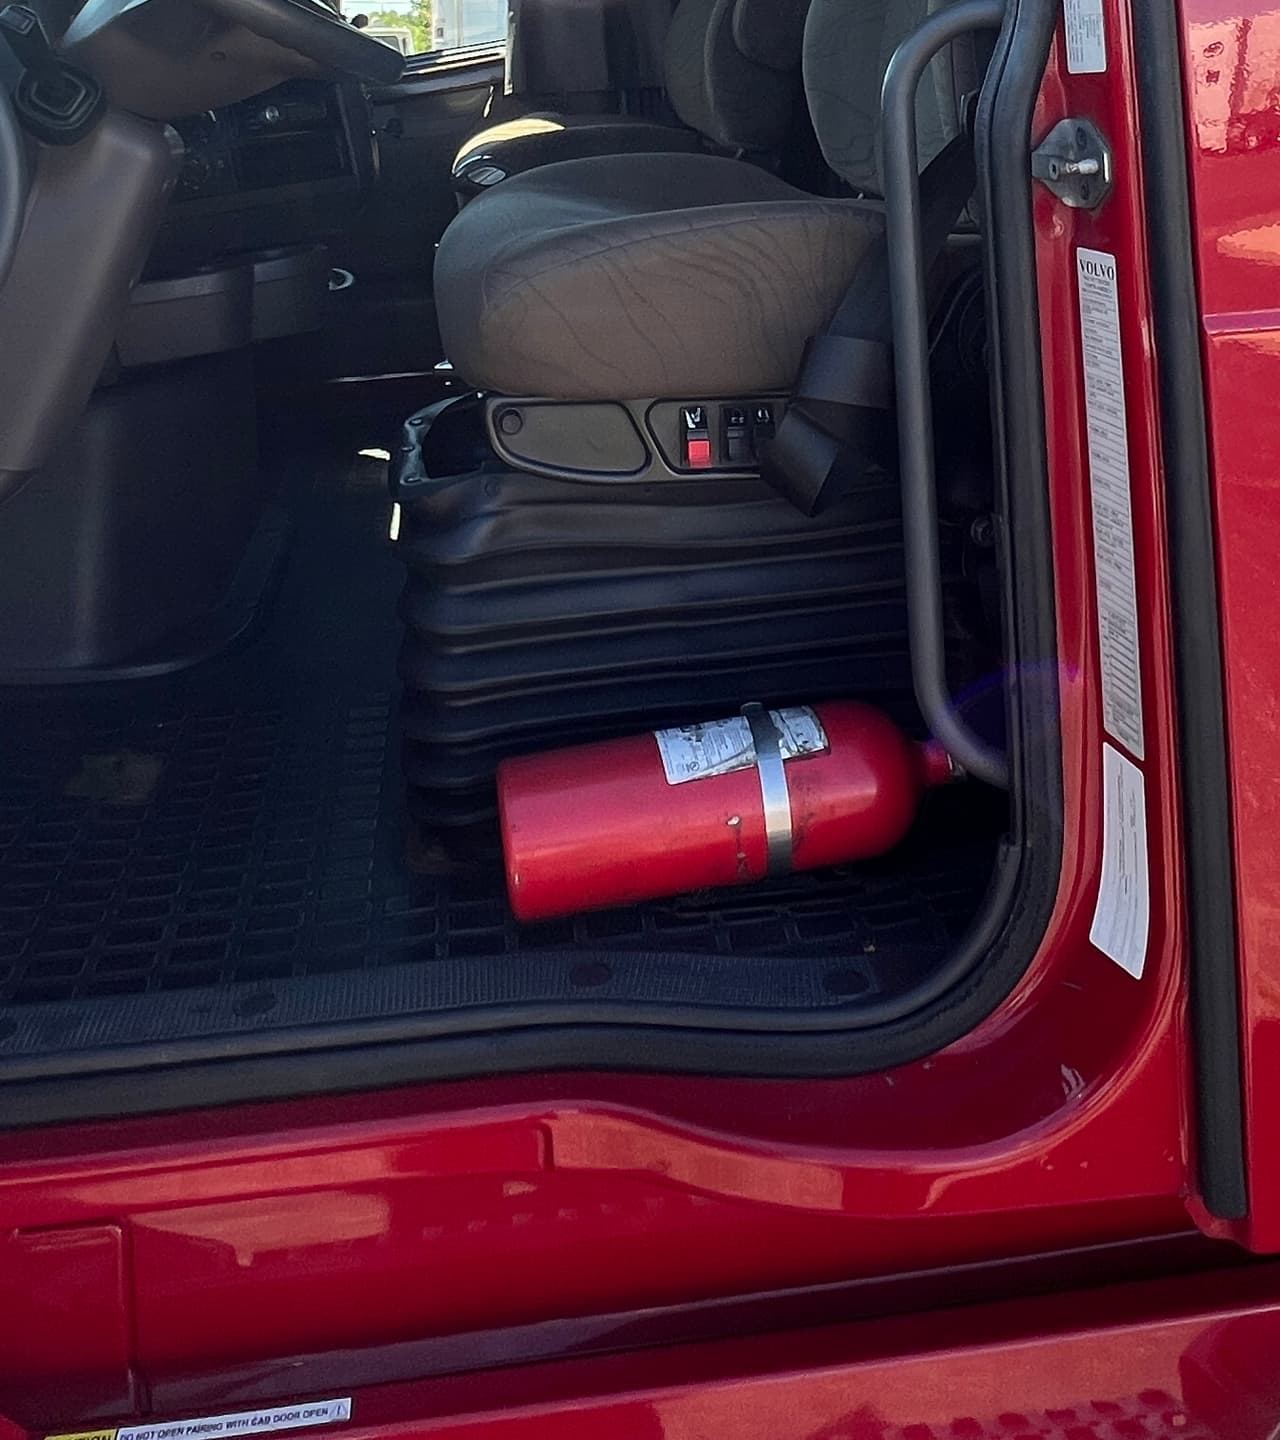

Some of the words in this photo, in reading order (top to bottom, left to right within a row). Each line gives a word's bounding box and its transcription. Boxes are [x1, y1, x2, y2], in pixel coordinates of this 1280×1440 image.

[1079, 259, 1115, 280] VOLVO
[136, 1431, 155, 1440] NOT
[158, 1427, 184, 1439] OPEN
[226, 1419, 249, 1429] WITH
[273, 1411, 301, 1423] DOOR
[303, 1407, 329, 1419] OPEN
